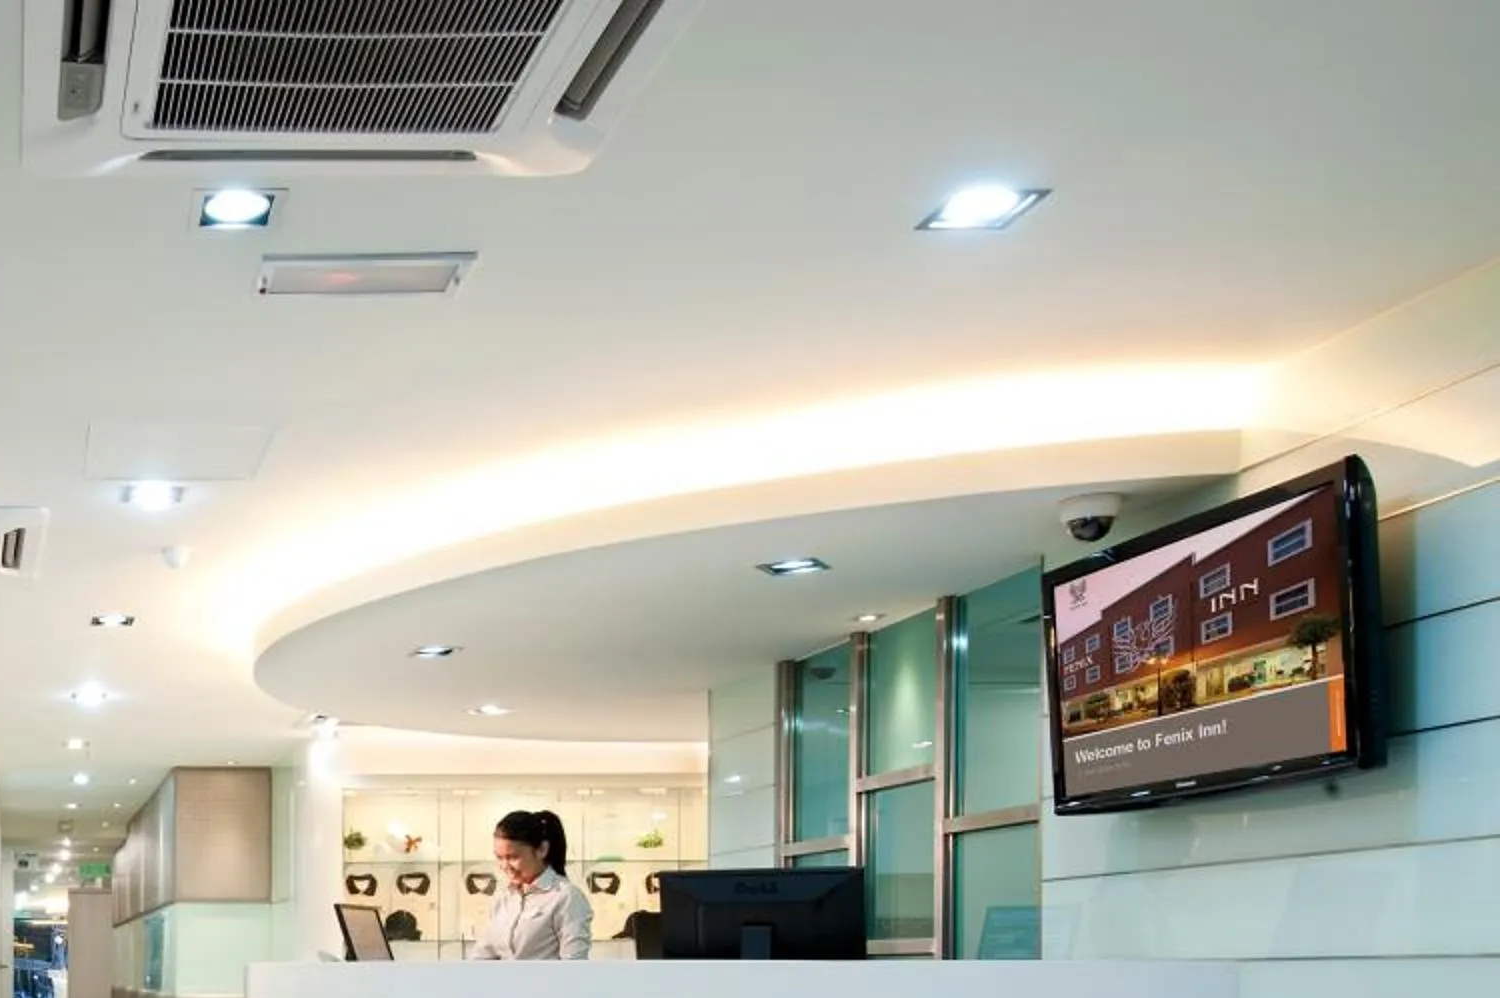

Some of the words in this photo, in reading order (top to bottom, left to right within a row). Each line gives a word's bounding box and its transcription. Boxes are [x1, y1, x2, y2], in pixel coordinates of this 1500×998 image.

[1211, 577, 1258, 612] INN
[1075, 741, 1133, 764] Welcome
[1137, 737, 1151, 751] to
[1155, 728, 1193, 748] Fenix
[1199, 719, 1227, 738] Inn!
